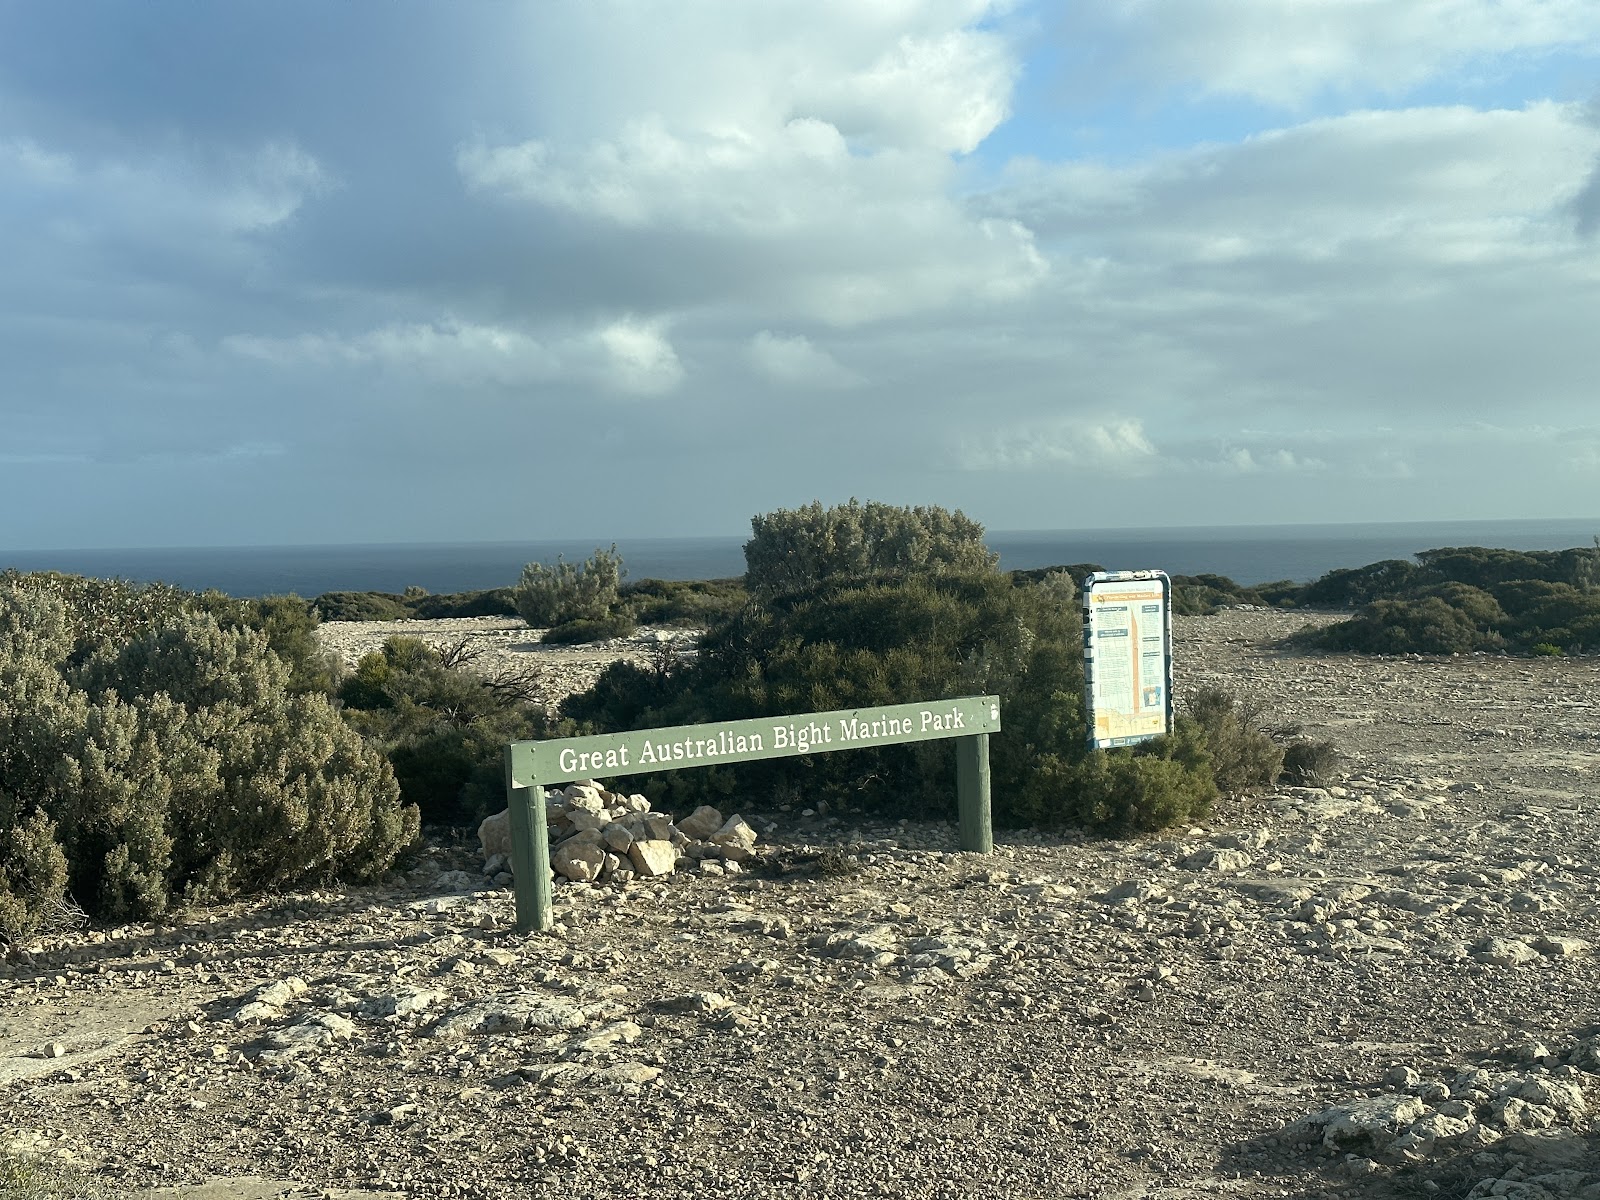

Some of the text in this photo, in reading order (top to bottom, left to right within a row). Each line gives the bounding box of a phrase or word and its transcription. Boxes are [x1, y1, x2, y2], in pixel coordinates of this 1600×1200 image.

[559, 707, 965, 773] Great Australian Bight Marine Park
